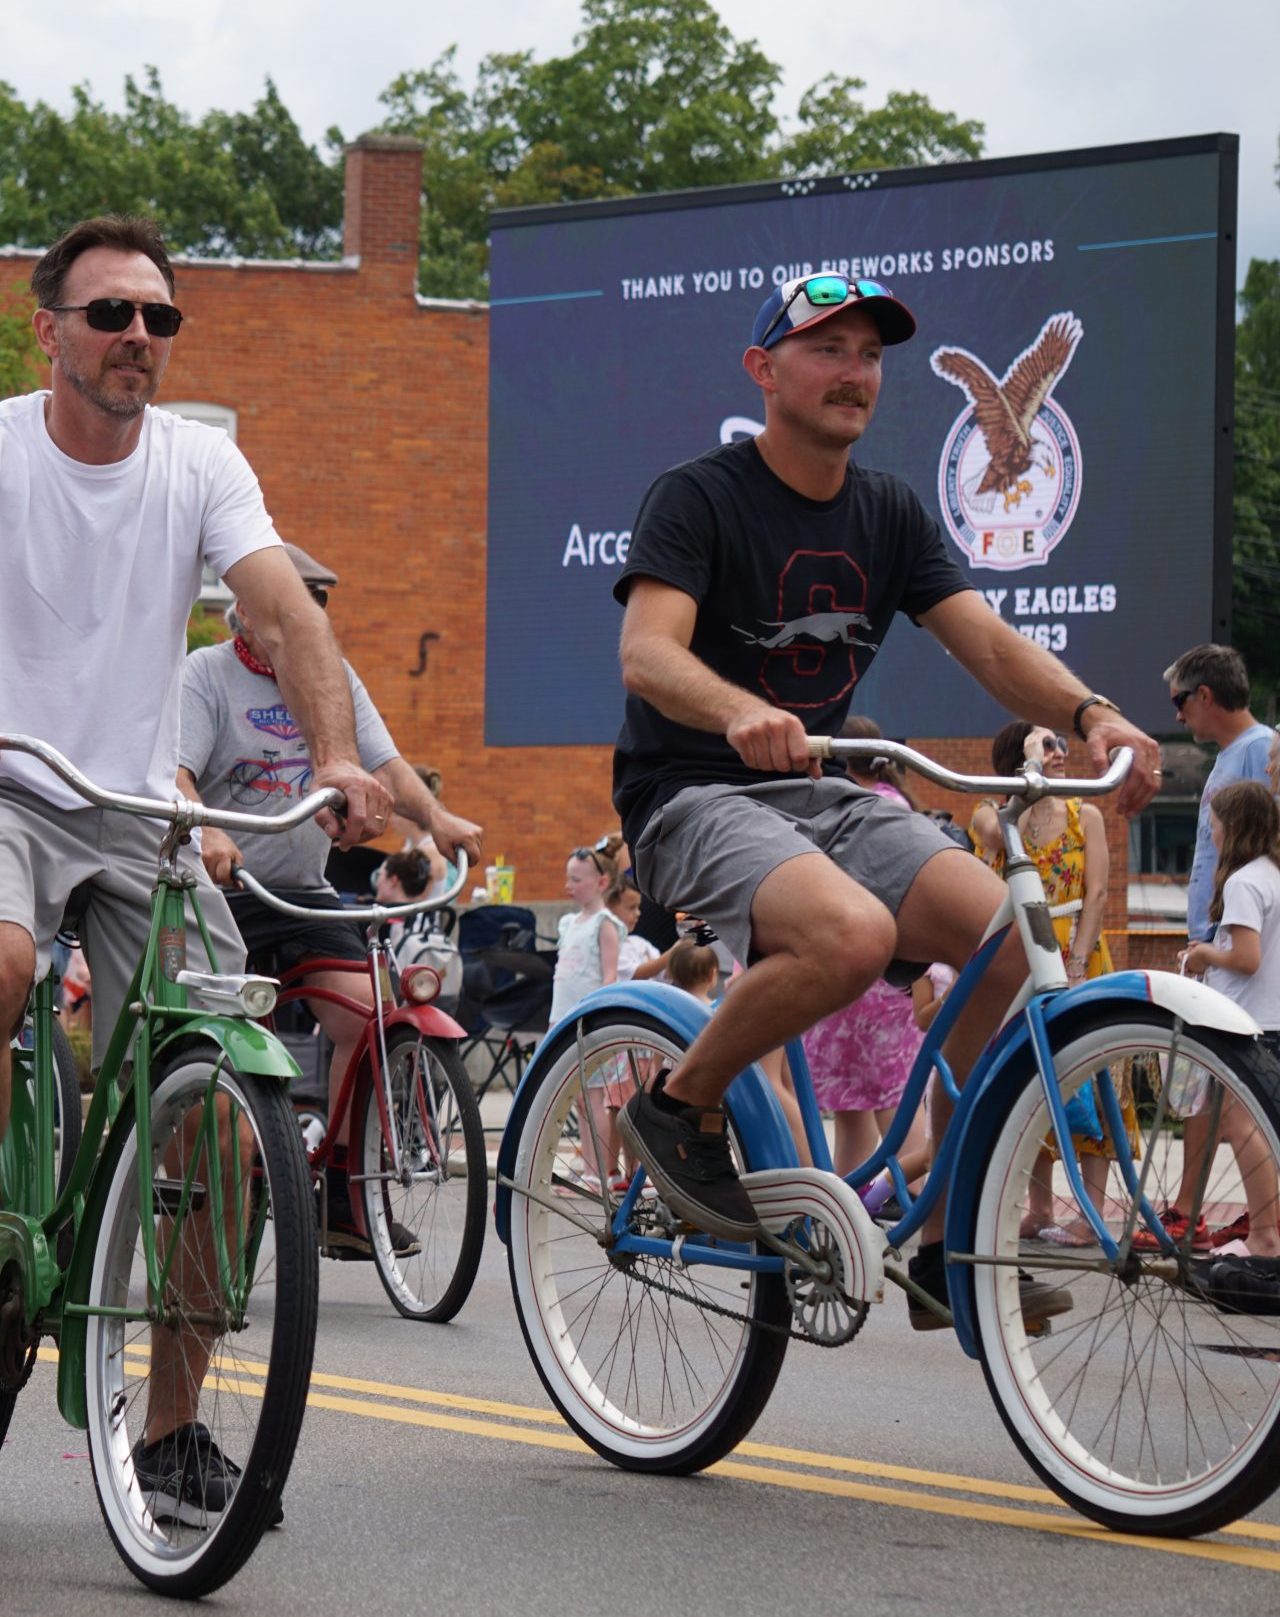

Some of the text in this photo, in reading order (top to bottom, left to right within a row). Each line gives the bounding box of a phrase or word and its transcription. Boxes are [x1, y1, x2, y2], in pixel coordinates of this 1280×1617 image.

[621, 274, 685, 300] THANK
[692, 269, 732, 294] YOU
[739, 266, 764, 289] TO
[821, 249, 934, 278] FIREWORKS
[942, 238, 1055, 271] SPONSORS
[1014, 584, 1117, 615] EAGLES
[1011, 622, 1068, 652] 763
